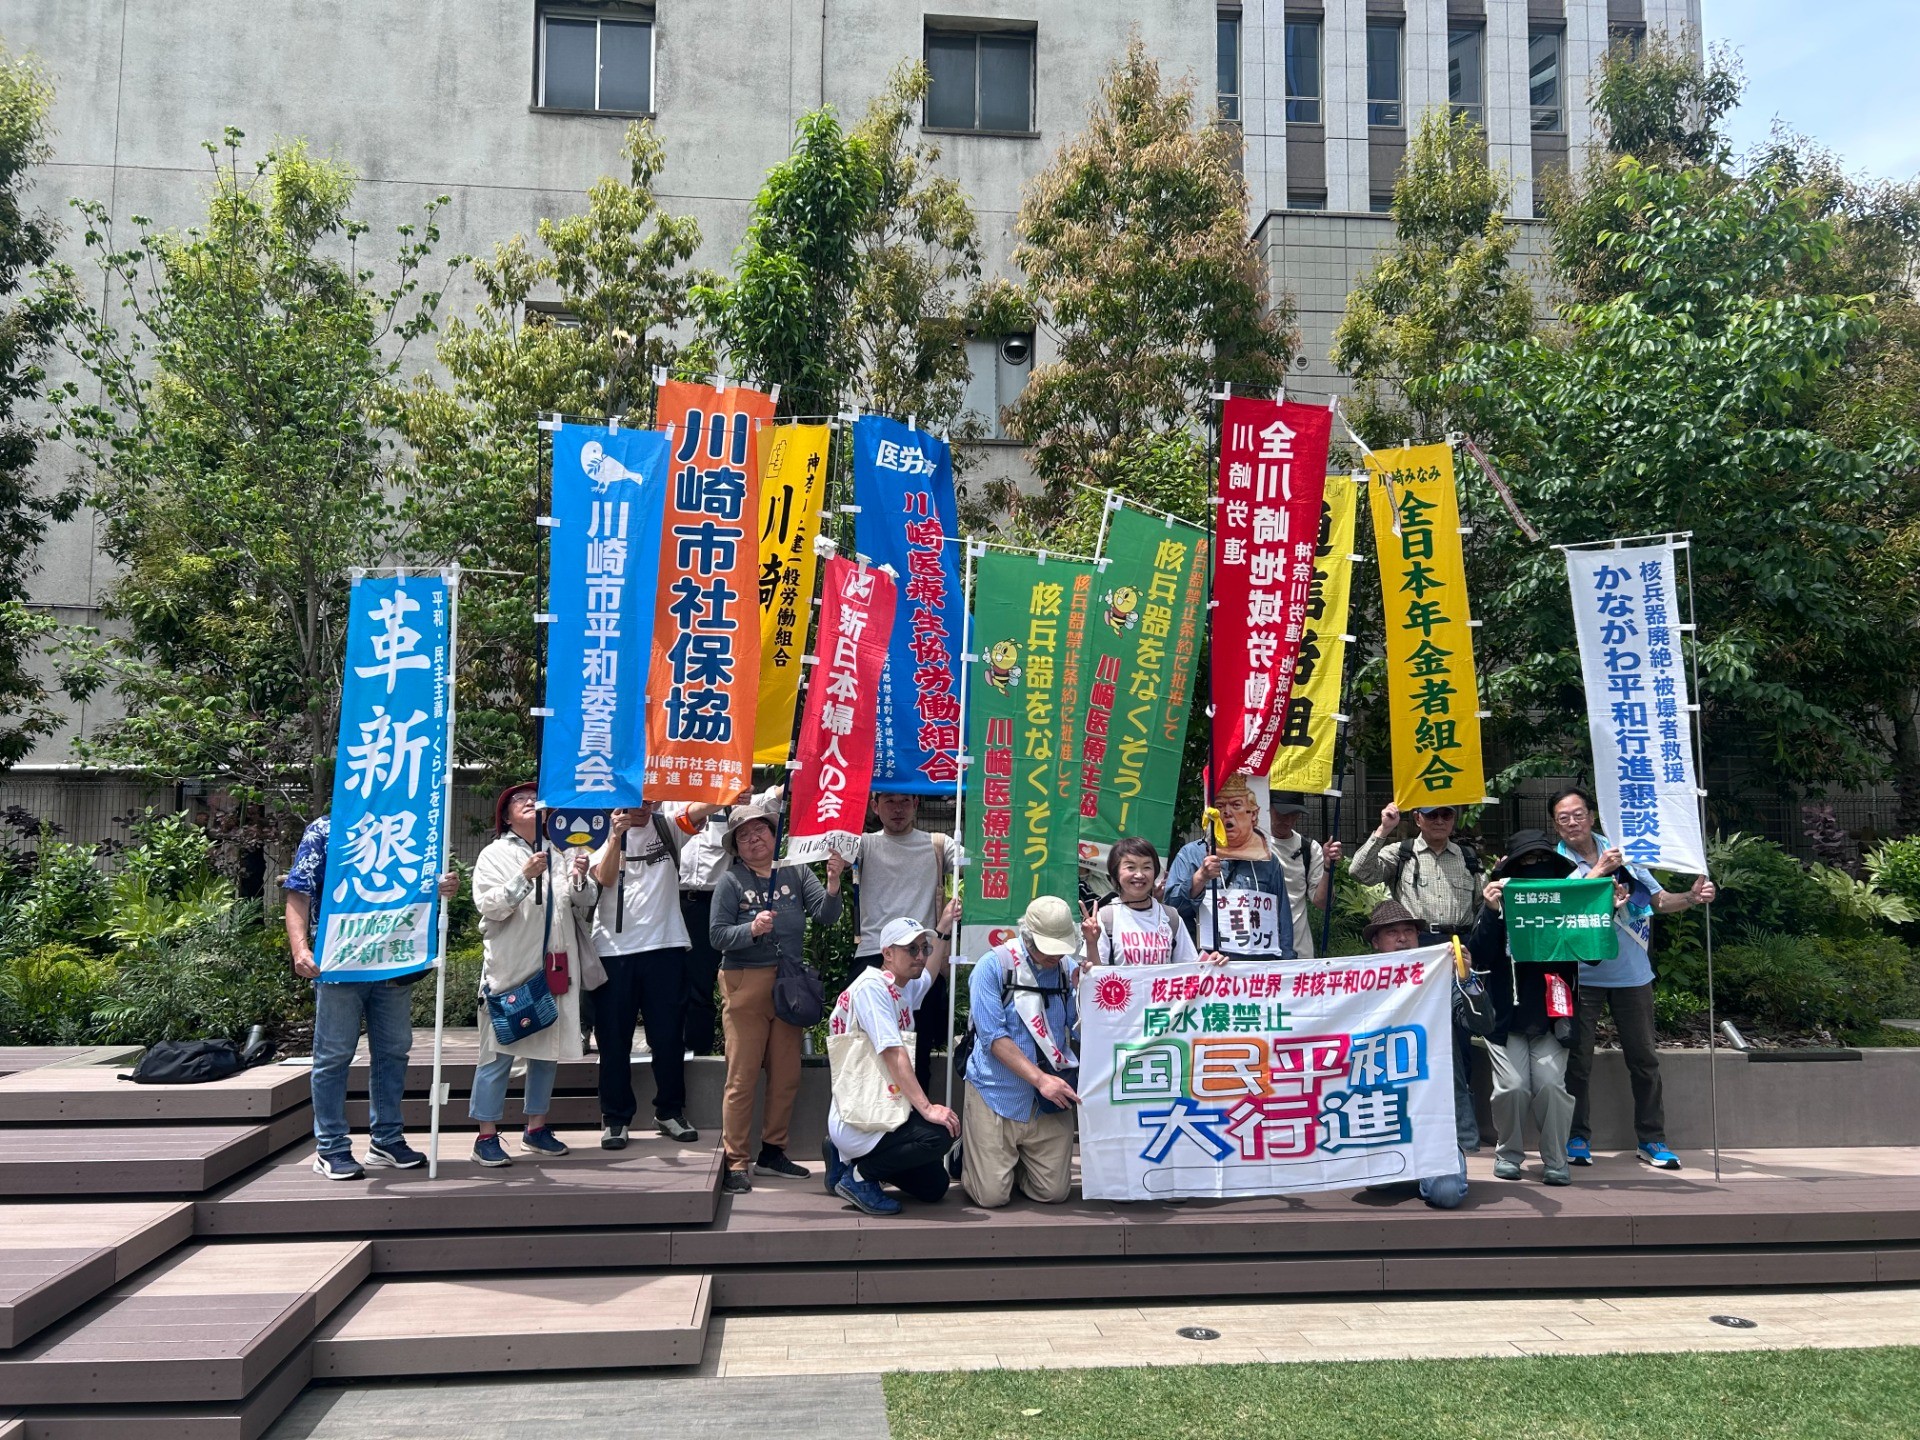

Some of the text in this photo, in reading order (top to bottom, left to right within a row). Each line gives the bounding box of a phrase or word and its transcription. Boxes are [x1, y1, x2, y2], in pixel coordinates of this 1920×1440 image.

[664, 408, 751, 745] 川崎市社保協
[574, 500, 630, 793] 川崎市平和委員会
[903, 491, 967, 783] 川崎医療生協労働組合
[1398, 489, 1464, 793] 全日本年金者組合
[1639, 560, 1686, 784] 核兵器廃絶・被爆者救援
[816, 603, 868, 823] 新日本婦人の会
[1113, 538, 1187, 832] 核兵器をなくそう！
[1593, 563, 1662, 864] かながわ平和行進懇談会
[332, 589, 431, 904] 革新懇
[643, 771, 742, 791] 推進協議会
[645, 755, 743, 775] 川崎市社会保障
[981, 717, 1013, 900] 川崎医療生協
[335, 908, 419, 942] 川崎区
[1514, 892, 1562, 904] 生協労連
[1514, 913, 1611, 929] ユーコープ労働組合
[332, 938, 417, 965] 革新懇
[1121, 931, 1170, 948] NO WAR
[1123, 948, 1141, 965] NO
[1218, 931, 1273, 949] トランプ
[1143, 1003, 1293, 1037] 原水爆禁止
[1151, 961, 1425, 1004] 核兵器のない世界 非核平和の日本を
[1111, 1026, 1428, 1104] 国民平和
[1139, 1089, 1411, 1164] 大行進
